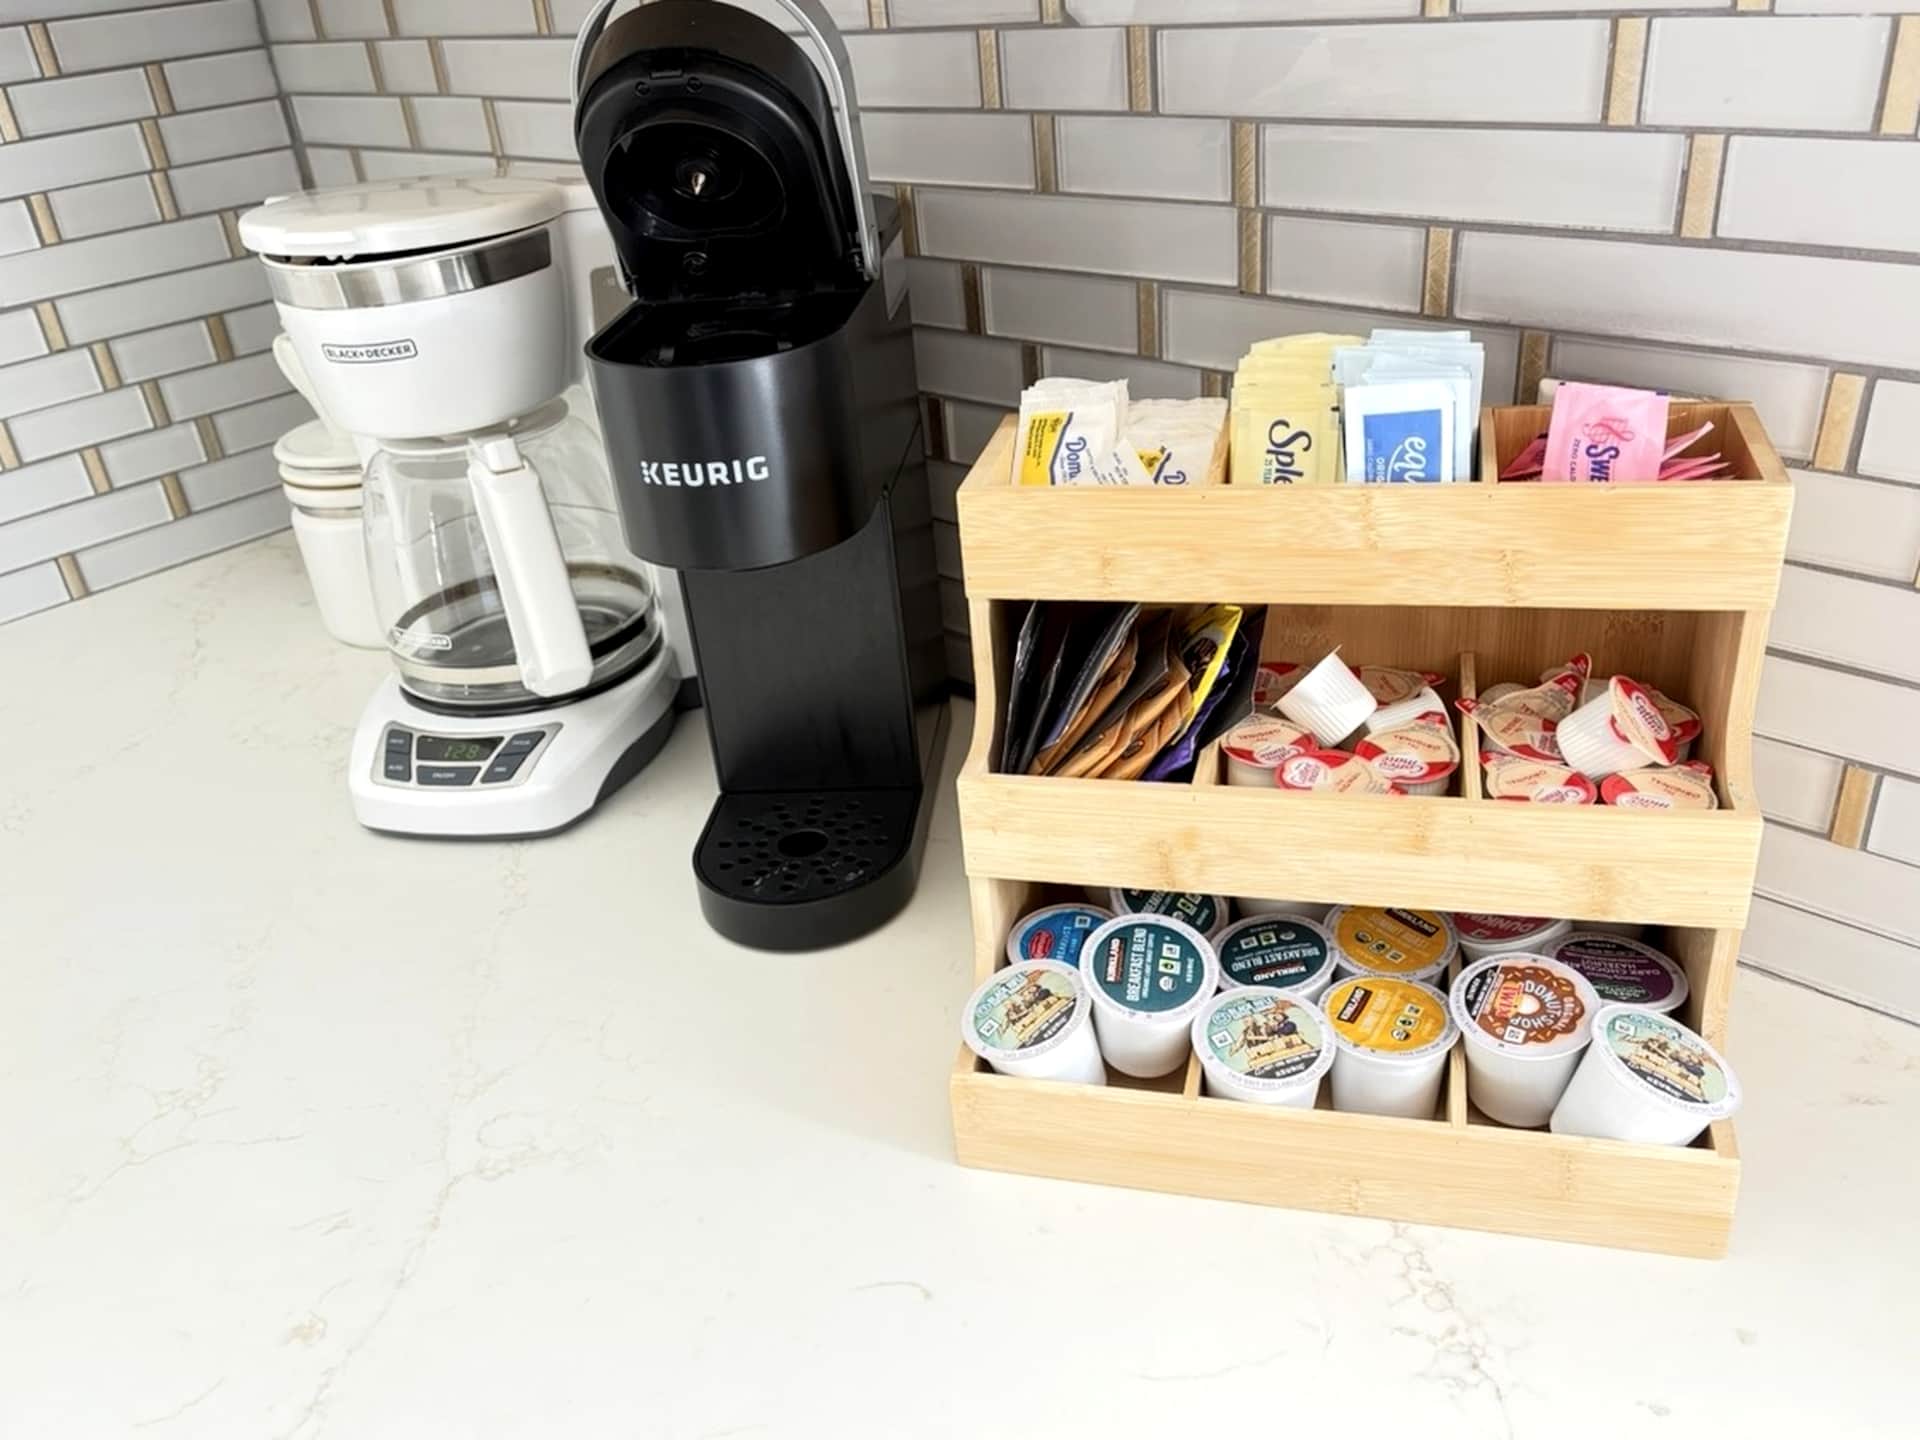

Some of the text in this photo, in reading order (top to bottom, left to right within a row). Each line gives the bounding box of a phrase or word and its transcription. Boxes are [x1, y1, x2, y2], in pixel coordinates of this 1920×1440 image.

[640, 456, 769, 487] KEURIG
[1231, 955, 1263, 972] BLEND
[1264, 946, 1321, 964] BREAKFAST
[1126, 927, 1148, 1002] BREAKFAST BLEND
[1253, 965, 1307, 982] KIRKLAND
